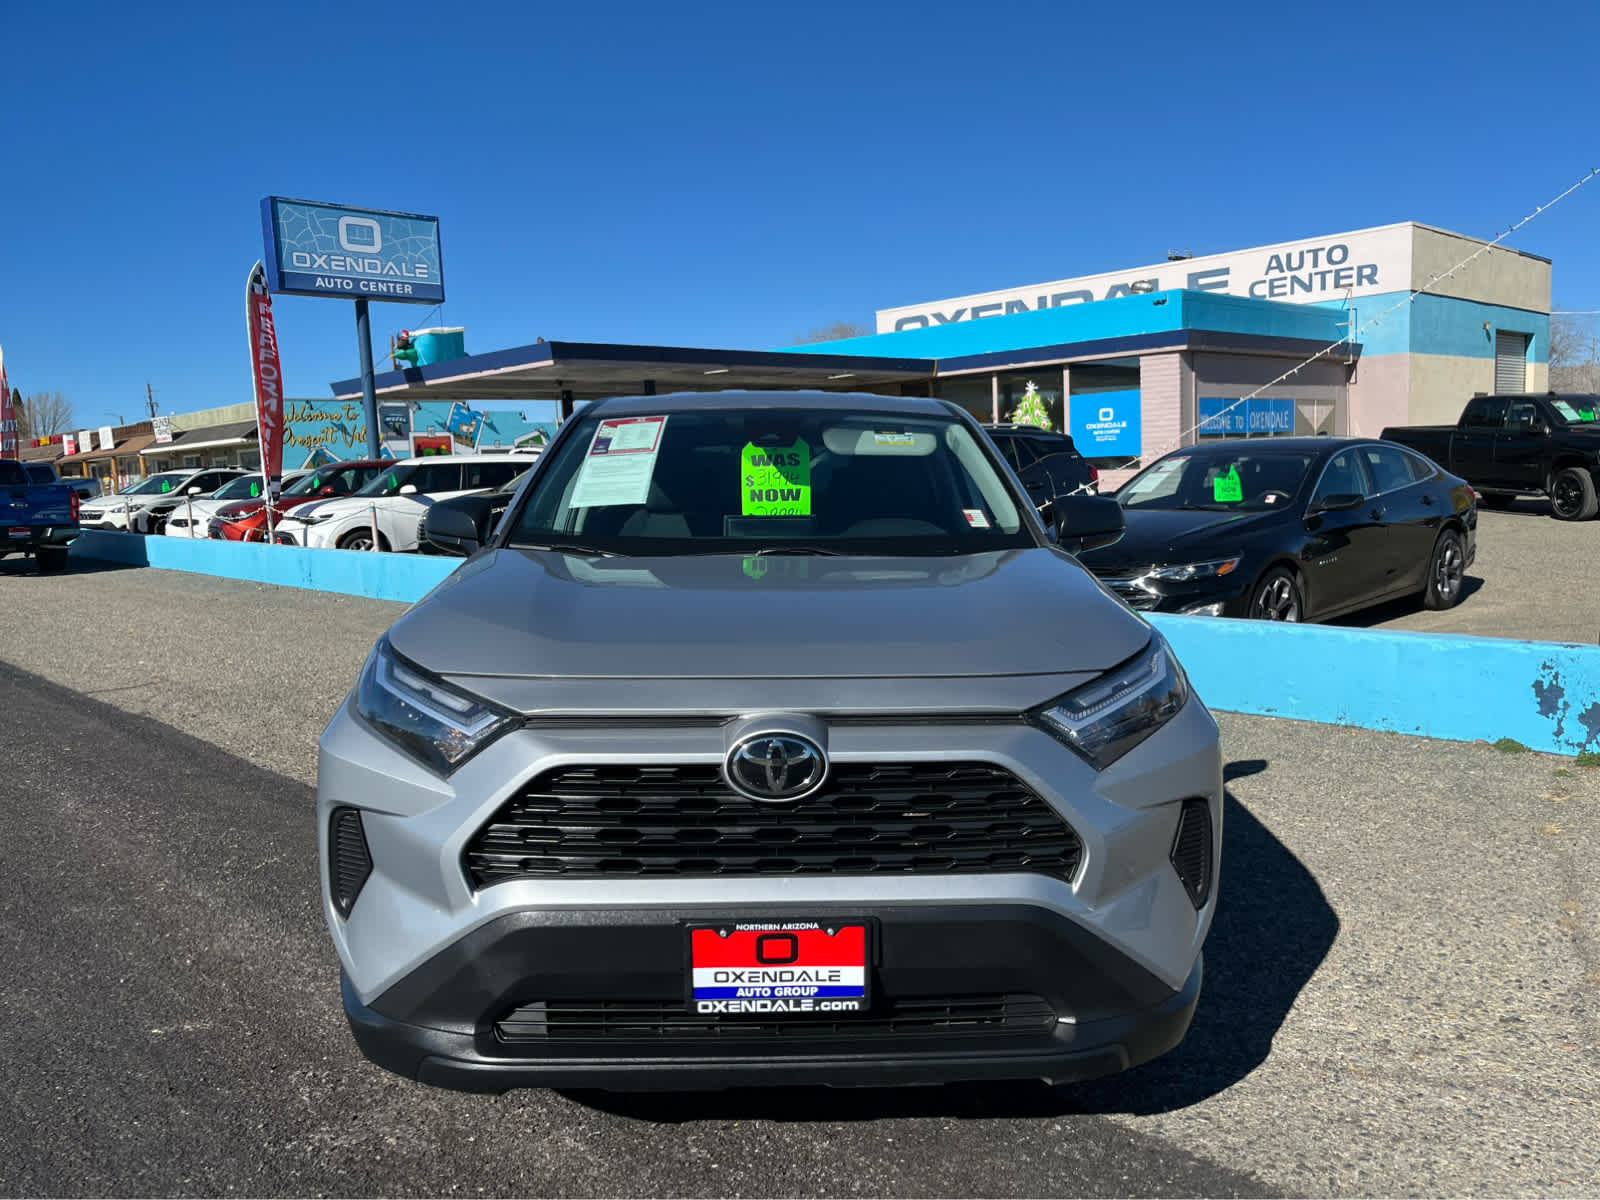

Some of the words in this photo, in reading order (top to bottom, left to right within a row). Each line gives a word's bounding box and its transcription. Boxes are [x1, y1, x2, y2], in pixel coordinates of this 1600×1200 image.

[292, 252, 429, 278] OXENDALE
[1265, 244, 1349, 275] AUTO
[315, 277, 353, 290] AUTO
[360, 280, 413, 295] CENTER
[1249, 263, 1378, 299] CENTER
[1249, 411, 1289, 429] OXENDALE
[750, 453, 801, 467] WAS
[750, 488, 801, 502] NOW
[736, 923, 780, 931] NORTHERN
[782, 922, 819, 930] ARIZONA
[714, 970, 841, 983] OXENDALE
[736, 987, 771, 997] AUTO
[774, 986, 818, 997] GROUP
[697, 1000, 859, 1014] OXENDALE.com
